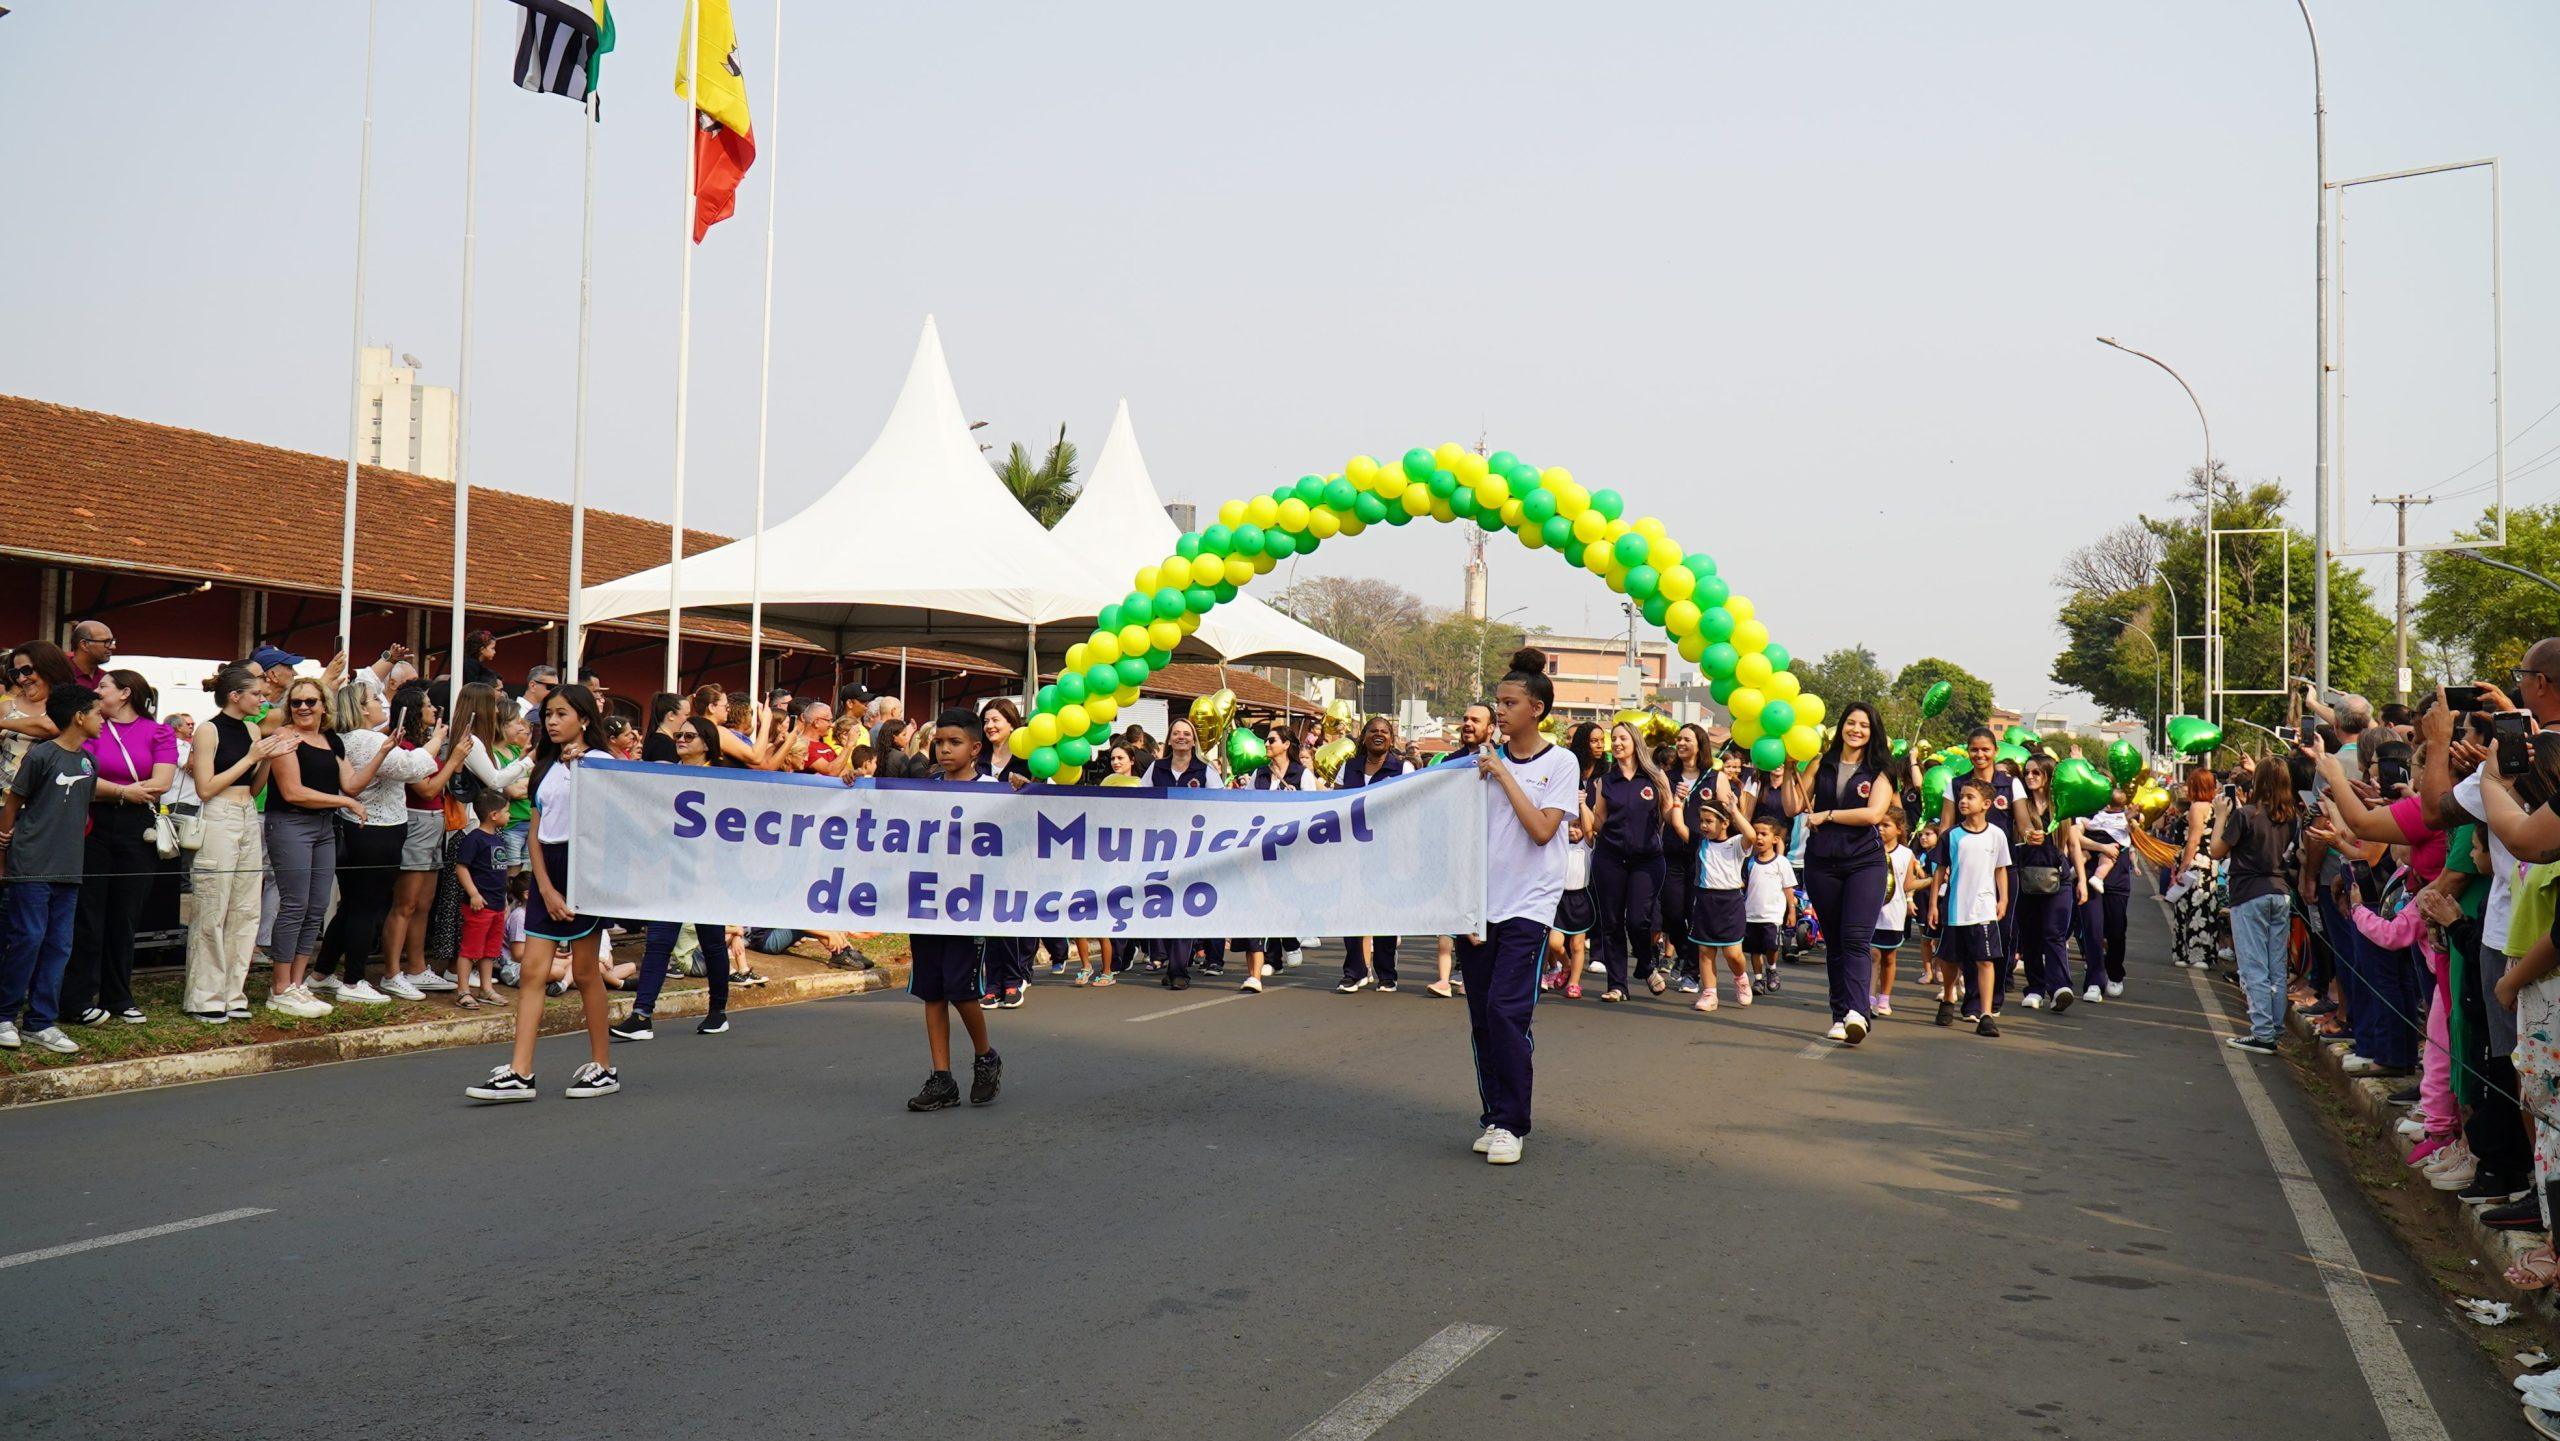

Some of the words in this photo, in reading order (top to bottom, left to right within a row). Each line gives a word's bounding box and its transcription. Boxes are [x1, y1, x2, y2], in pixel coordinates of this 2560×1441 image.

[673, 791, 1004, 857] Secretaria
[1036, 797, 1375, 863] Municipal
[806, 867, 879, 918] de
[907, 870, 1218, 932] Educação
